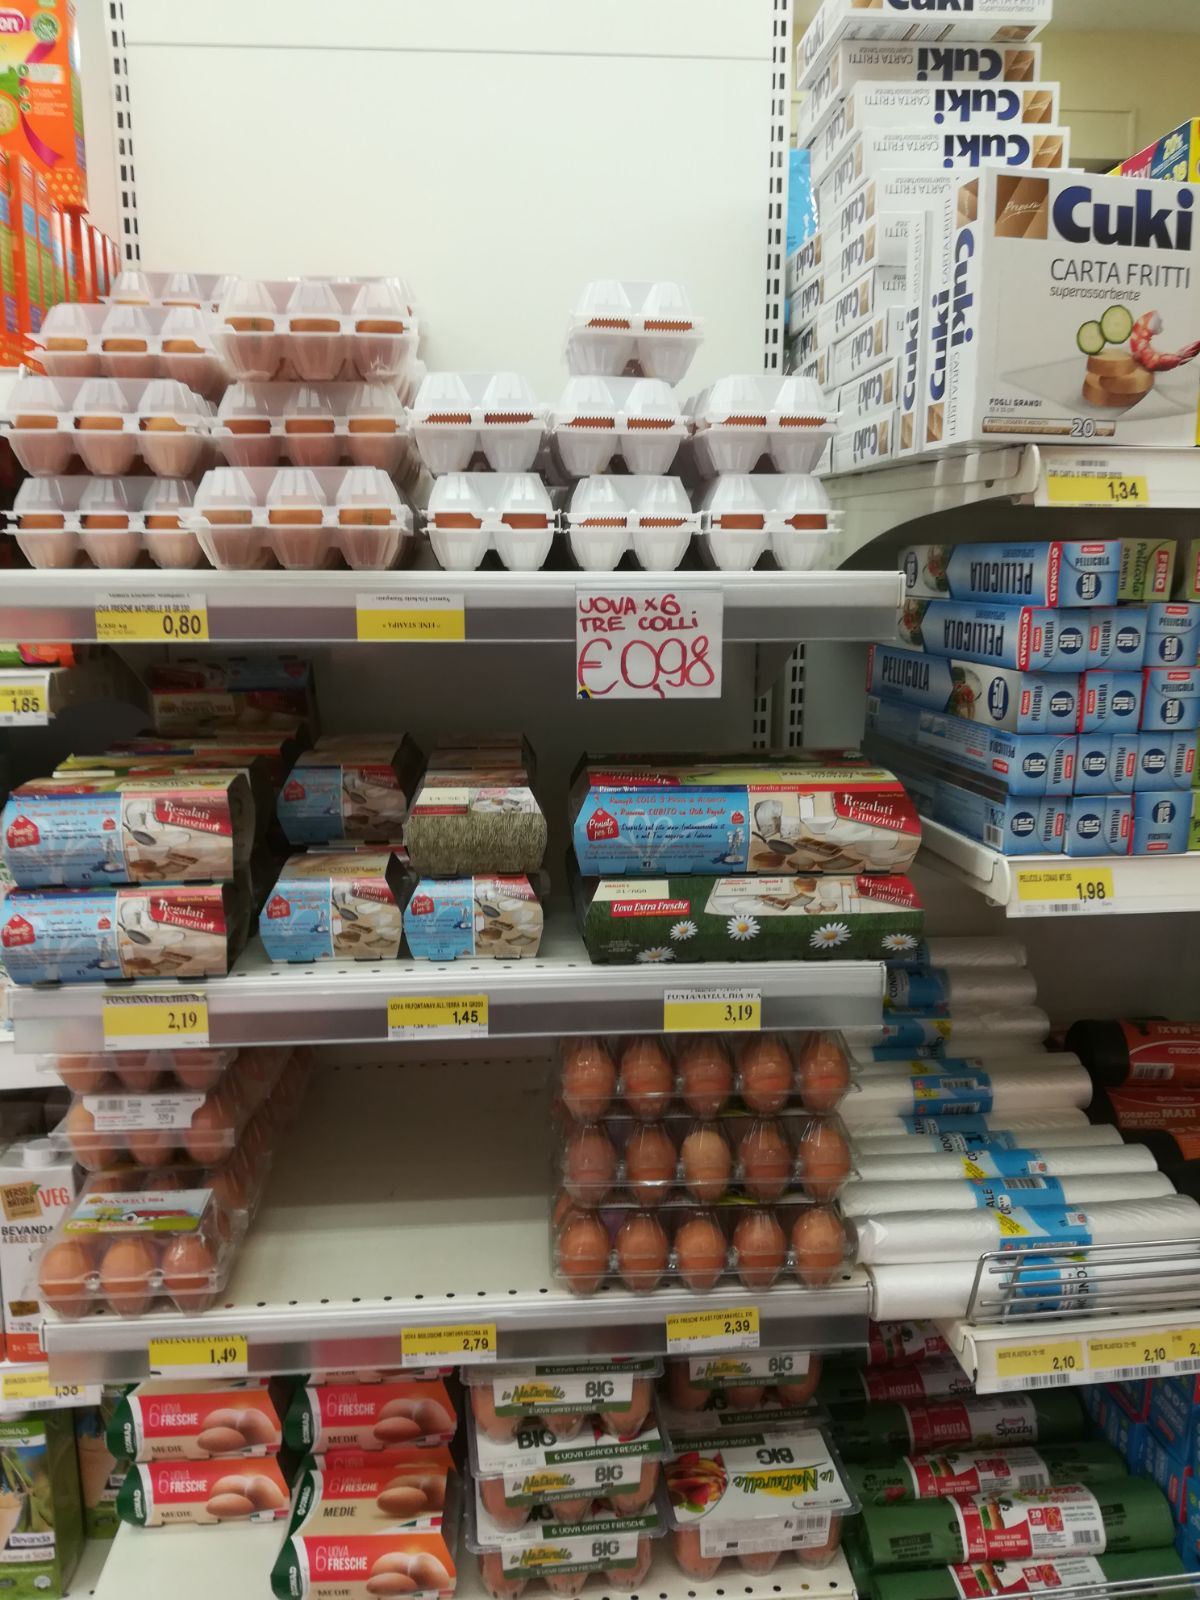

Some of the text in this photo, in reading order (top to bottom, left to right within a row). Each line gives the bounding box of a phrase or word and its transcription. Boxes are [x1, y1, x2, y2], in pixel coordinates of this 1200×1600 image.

[849, 54, 913, 64] CARTA FRITTI
[916, 48, 1003, 81] Cuki
[865, 95, 930, 105] CARTA FRITTI
[933, 89, 1020, 124] Cuki
[873, 141, 939, 151] CARTA FRITTI
[942, 134, 1030, 168] Cuki
[884, 184, 917, 194] FRITTI
[1053, 186, 1194, 251] Cuki
[1050, 259, 1190, 289] CARTA FRITTI
[951, 228, 974, 347] Cuki
[1049, 286, 1141, 302] superassorbente
[929, 289, 950, 402] Cuki
[903, 306, 920, 411] Cuki
[1071, 418, 1096, 437] 20
[1108, 481, 1139, 502] 1,34
[1075, 557, 1110, 567] PELLICOLA
[1133, 543, 1147, 596] Pellicola
[970, 561, 1034, 595] PELLICOLA
[1049, 559, 1058, 602] CONAD
[1081, 574, 1097, 593] 50
[579, 596, 637, 615] UOVA
[162, 615, 202, 637] 0,80
[579, 616, 626, 632] TRE
[944, 619, 1005, 657] PELLICOLA
[1020, 625, 1029, 666] CONAD
[1043, 621, 1054, 658] PELLICOLA
[1059, 635, 1076, 648] 50
[1101, 620, 1112, 657] PELLICOLA
[1117, 633, 1133, 647] 50
[1164, 637, 1178, 655] 50
[882, 656, 930, 691] PELLICOLA
[11, 697, 40, 715] 1,85
[1031, 685, 1043, 721] PELLICOLA
[1051, 697, 1068, 711] 50
[1097, 683, 1108, 720] PELLICOLA
[1112, 696, 1129, 710] 50
[1030, 758, 1046, 772] 50
[1053, 749, 1064, 785] PELLICOLA
[1090, 757, 1106, 770] 50
[1115, 747, 1126, 783] PELLICOLA
[1150, 754, 1166, 768] 50
[164, 801, 210, 820] Regalati
[843, 793, 893, 815] Regalati
[168, 813, 221, 832] Emozioni
[849, 806, 908, 829] Emozioni
[1017, 818, 1034, 831] 50
[1084, 819, 1100, 833] 50
[861, 878, 905, 896] Regalati
[1076, 881, 1106, 903] 1,98
[613, 900, 688, 913] Uova Extra Fresche
[868, 889, 916, 907] Emozioni
[158, 899, 204, 919] Regalati
[163, 913, 215, 931] Emozioni
[168, 1011, 197, 1031] 2,19
[453, 1010, 478, 1025] 1,45
[724, 1004, 752, 1024] 3,19
[1162, 1109, 1196, 1118] MAXI
[4, 1186, 28, 1199] VERSO
[39, 1187, 70, 1208] VEG
[9, 1236, 28, 1244] BASE
[724, 1319, 750, 1334] 2,39
[463, 1338, 488, 1351] 2,79
[209, 1348, 237, 1364] 1,49
[1052, 1356, 1075, 1371] 2,10
[1144, 1347, 1166, 1363] 2,10
[769, 1357, 793, 1372] BIG
[585, 1381, 614, 1397] BIG
[327, 1393, 338, 1417] 6
[338, 1403, 375, 1416] FRESCHE
[149, 1403, 161, 1428] 6
[160, 1413, 198, 1427] FRESCHE
[328, 1435, 359, 1444] MEDIE
[517, 1429, 557, 1449] BIG
[152, 1445, 183, 1453] MEDIE
[562, 1452, 583, 1460] UOVA
[585, 1448, 614, 1457] GRANDI
[614, 1444, 649, 1454] FRESCHE
[756, 1448, 794, 1465] BIG
[158, 1470, 170, 1494] 6
[595, 1465, 623, 1482] BIG
[732, 1470, 819, 1494] Naturelle
[170, 1480, 208, 1493] FRESCHE
[323, 1506, 357, 1517] MEDIE
[1030, 1510, 1042, 1518] 20
[559, 1525, 580, 1534] UOVA
[582, 1522, 610, 1532] GRANDI
[611, 1519, 646, 1528] FRESCHE
[12, 1534, 51, 1545] Bevanda
[591, 1540, 620, 1557] BIG
[315, 1546, 327, 1572] 6
[328, 1557, 368, 1571] FRESCHE
[1025, 1569, 1036, 1577] 20
[317, 1589, 350, 1597] MEDIE
